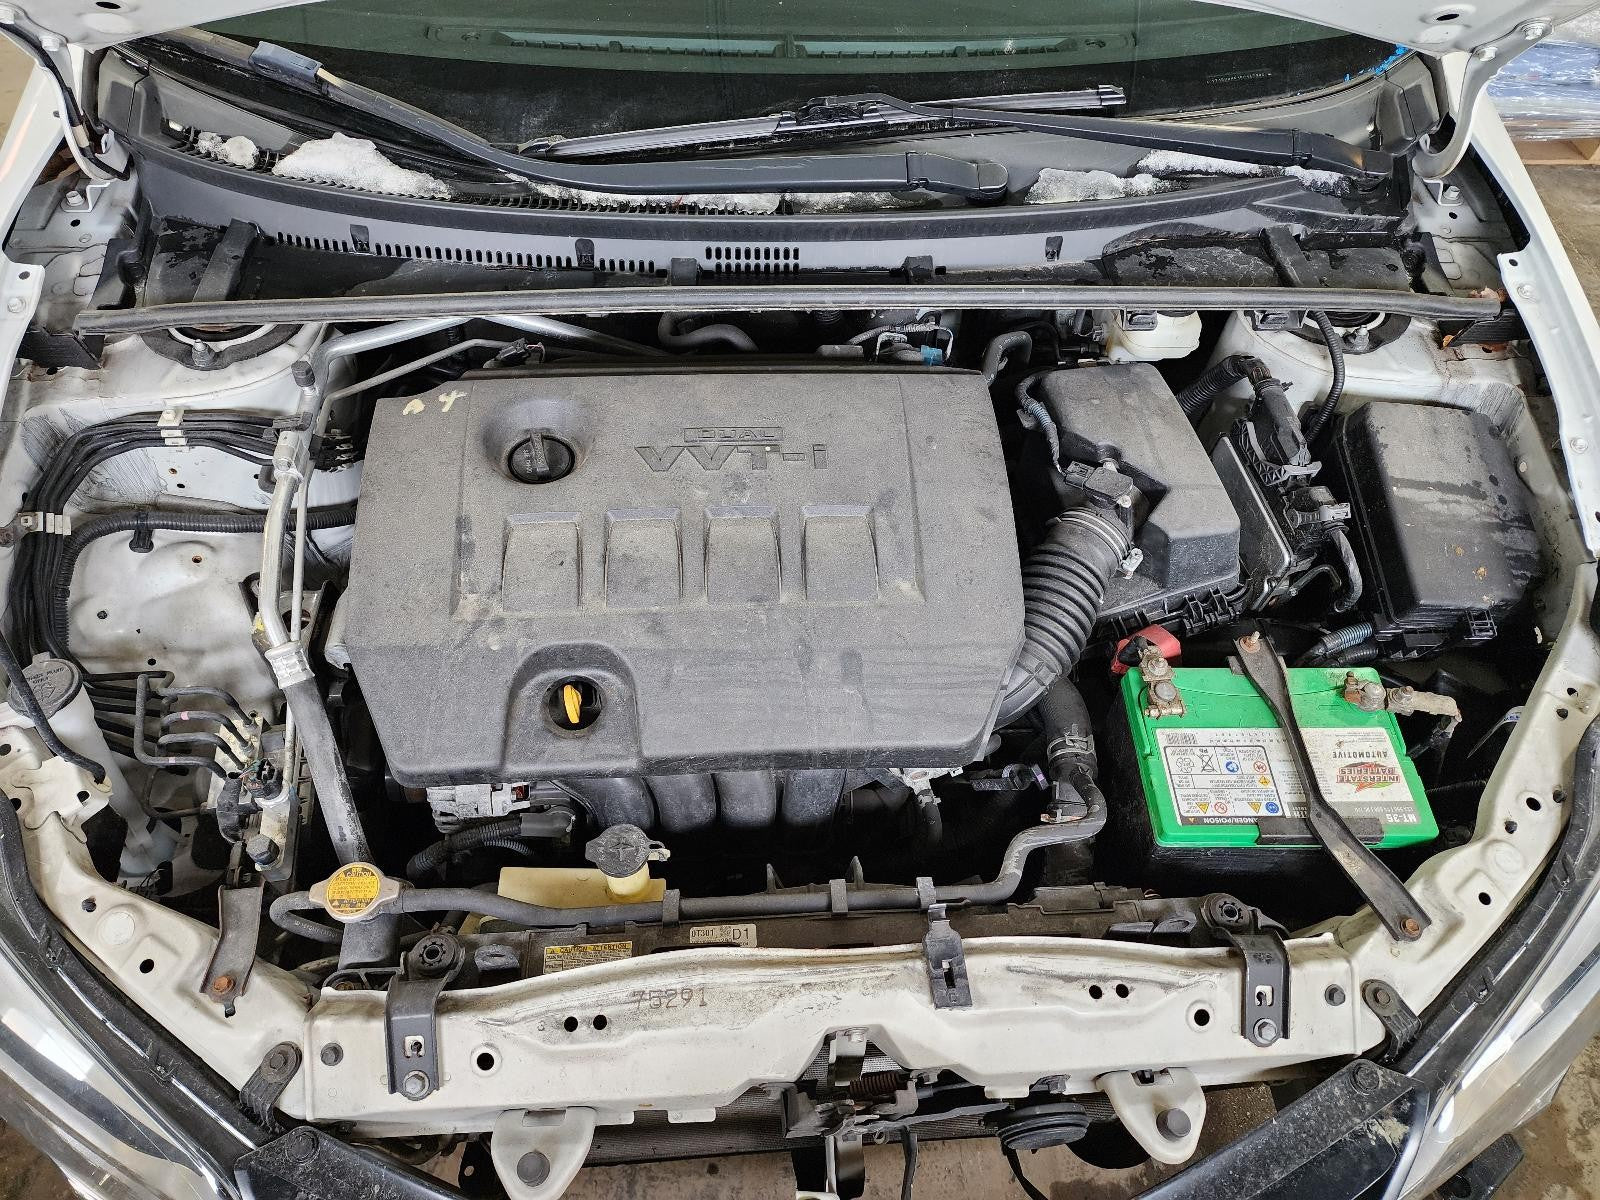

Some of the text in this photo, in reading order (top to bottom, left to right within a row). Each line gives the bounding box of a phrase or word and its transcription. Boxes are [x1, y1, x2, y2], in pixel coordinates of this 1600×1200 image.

[697, 429, 775, 440] DUAL
[634, 444, 828, 472] VVT-i
[1332, 751, 1388, 759] AUTOMOTIVE
[1339, 767, 1396, 776] BATTERIES
[1337, 775, 1400, 784] INTERSTATE
[732, 928, 749, 940] D1
[633, 987, 707, 1009] 75291
